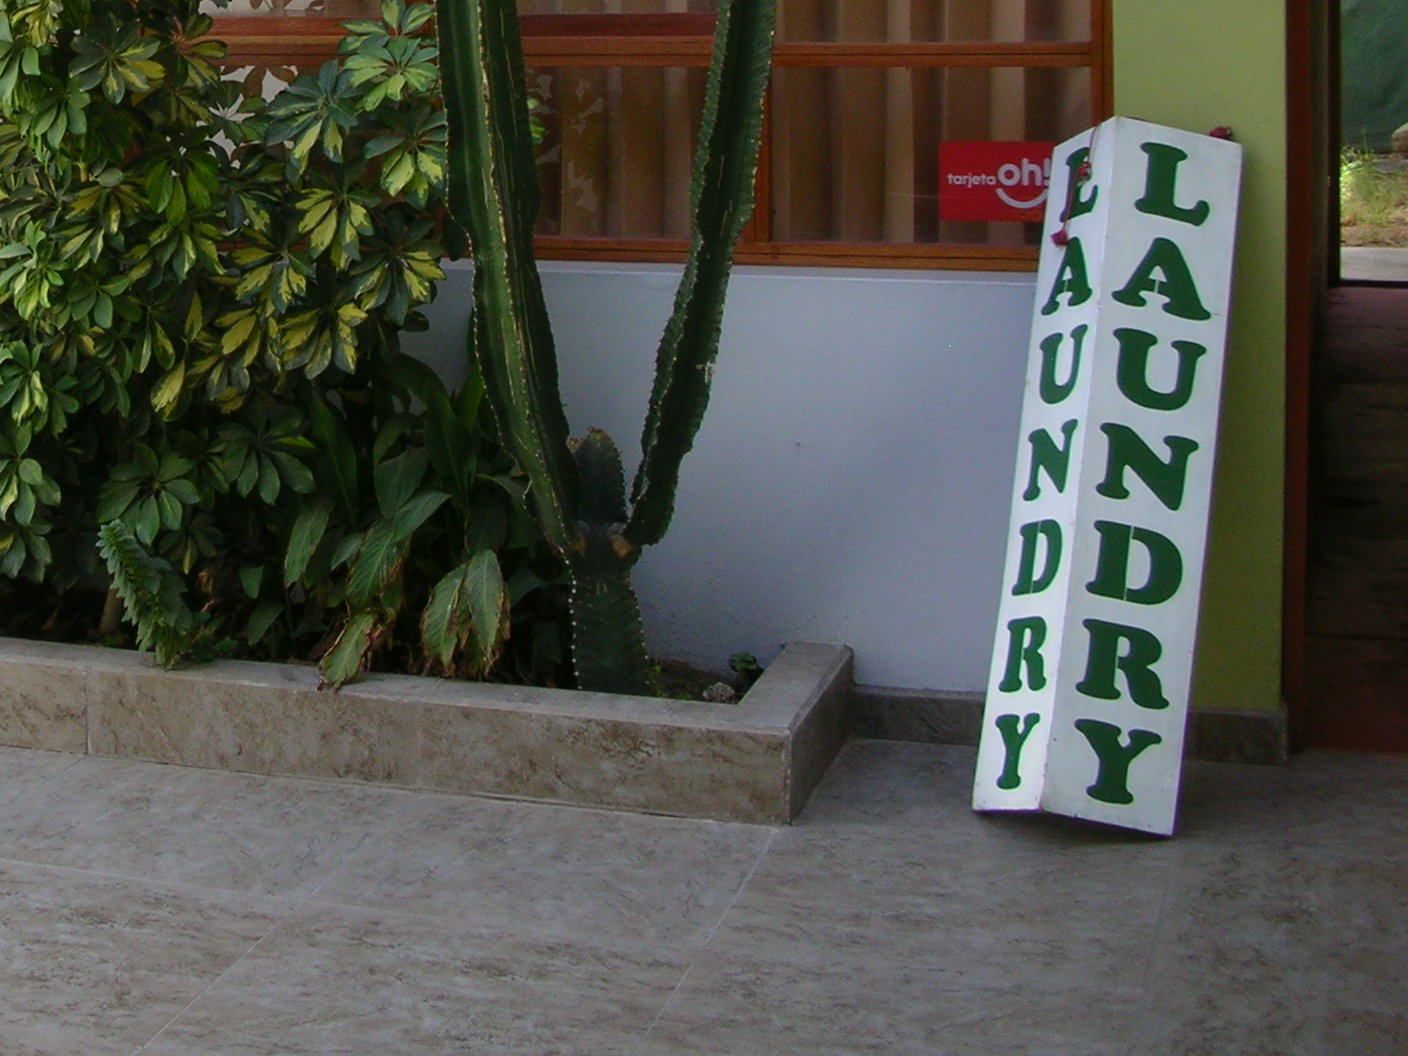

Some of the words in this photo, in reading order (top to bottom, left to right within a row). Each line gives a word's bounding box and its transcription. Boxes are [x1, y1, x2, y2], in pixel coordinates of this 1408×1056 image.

[947, 172, 996, 189] tarjeta
[997, 157, 1051, 186] oh!
[994, 146, 1099, 791] LAUNDRY
[1074, 141, 1212, 806] LAUNDRY
